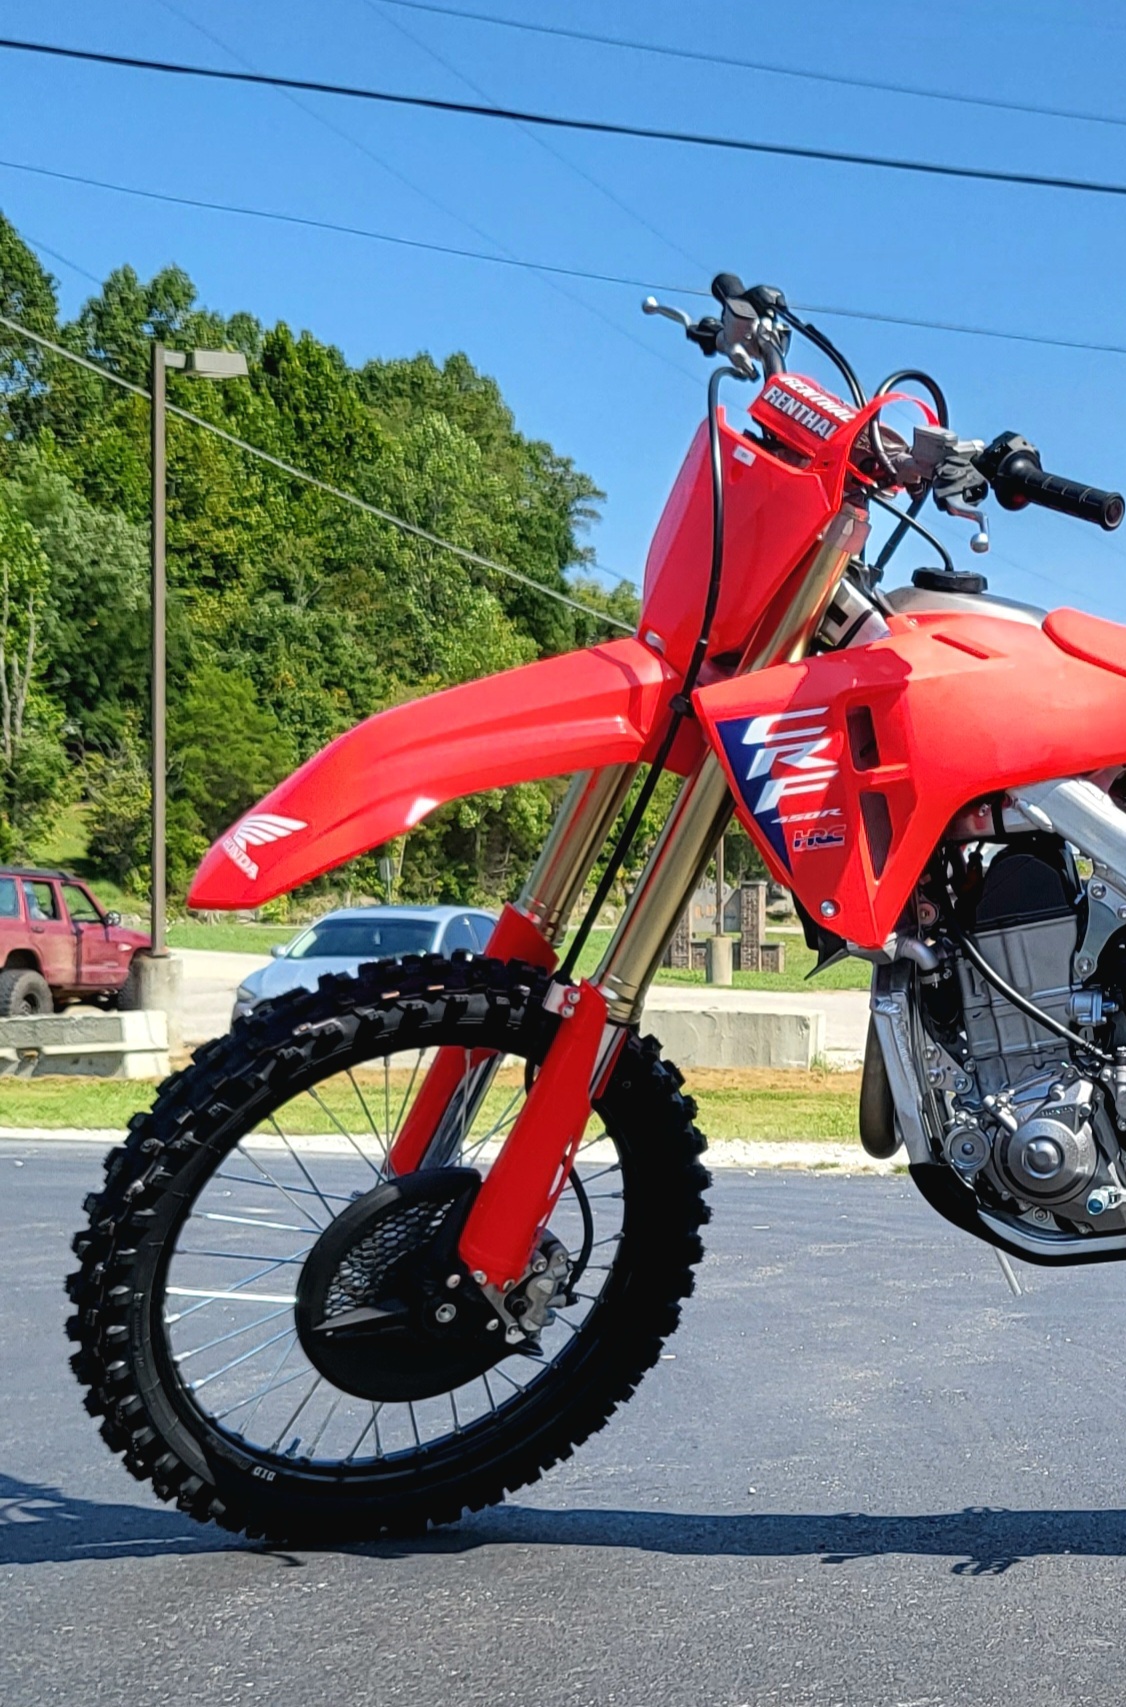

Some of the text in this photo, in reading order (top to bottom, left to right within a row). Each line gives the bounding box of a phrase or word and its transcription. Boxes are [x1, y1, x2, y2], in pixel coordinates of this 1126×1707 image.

[741, 706, 839, 815] CRF
[770, 808, 844, 824] 450R
[793, 824, 846, 852] HRC
